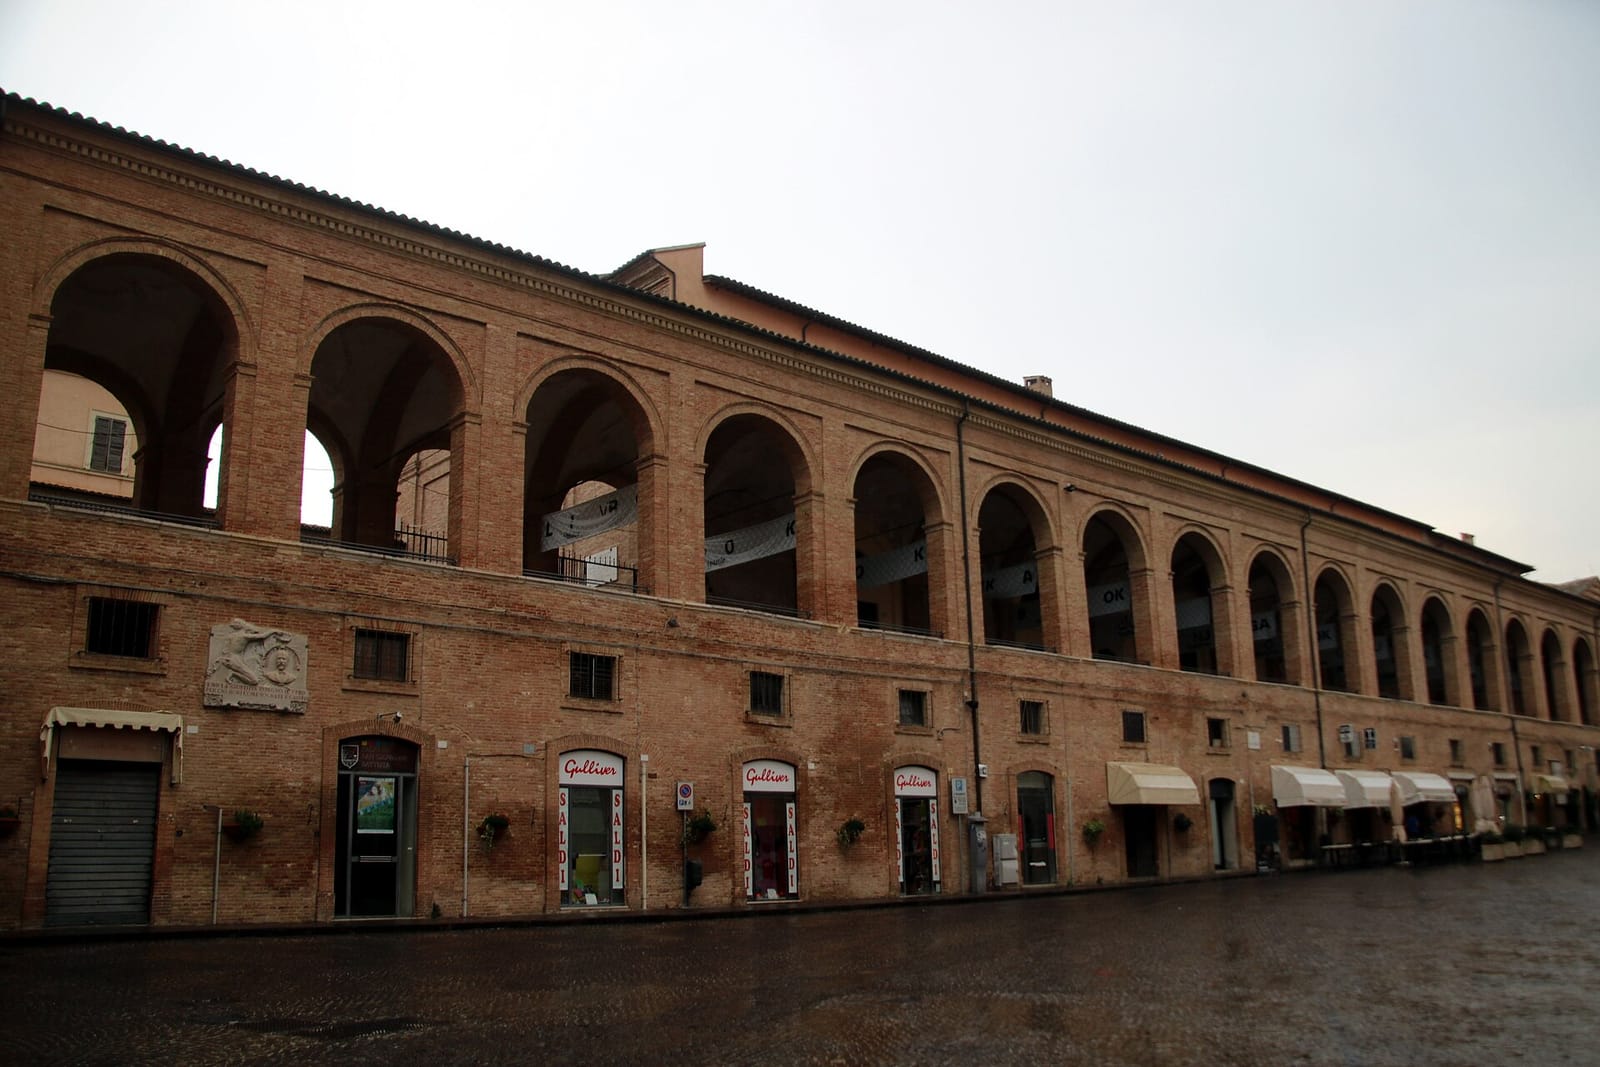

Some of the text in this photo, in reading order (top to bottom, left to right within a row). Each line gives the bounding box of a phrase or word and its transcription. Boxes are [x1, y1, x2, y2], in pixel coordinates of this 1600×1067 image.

[1103, 588, 1125, 604] OK
[564, 759, 617, 779] Gulliver
[746, 768, 790, 786] Gulliver
[896, 774, 932, 790] Gulliver
[559, 793, 567, 883] SALDI
[613, 794, 621, 882] SALDI
[787, 807, 795, 887] SALDI
